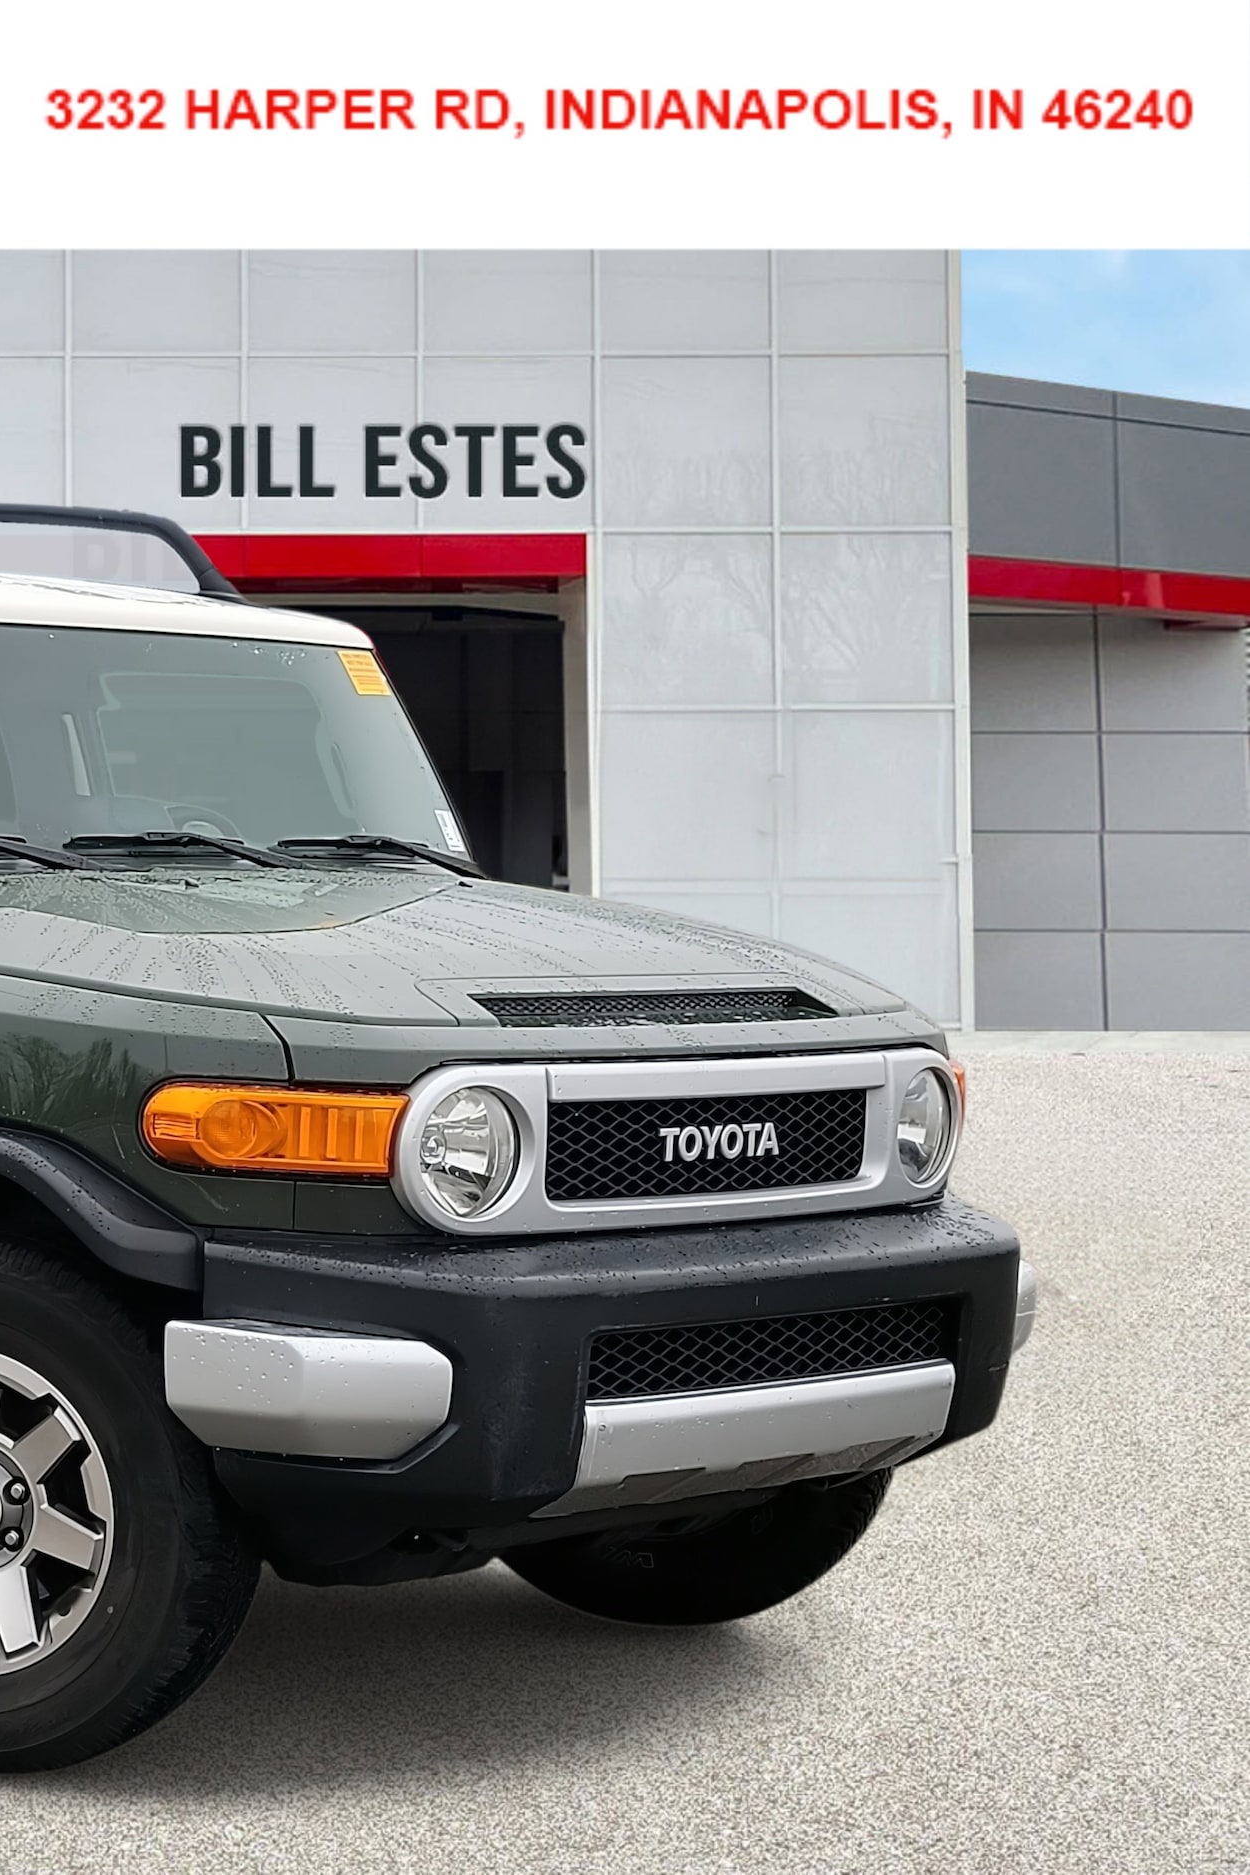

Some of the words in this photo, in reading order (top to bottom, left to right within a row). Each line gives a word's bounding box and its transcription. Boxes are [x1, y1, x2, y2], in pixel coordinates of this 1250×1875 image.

[180, 424, 336, 498] BILL
[364, 423, 587, 499] ESTES
[659, 1121, 780, 1163] TOYOTA
